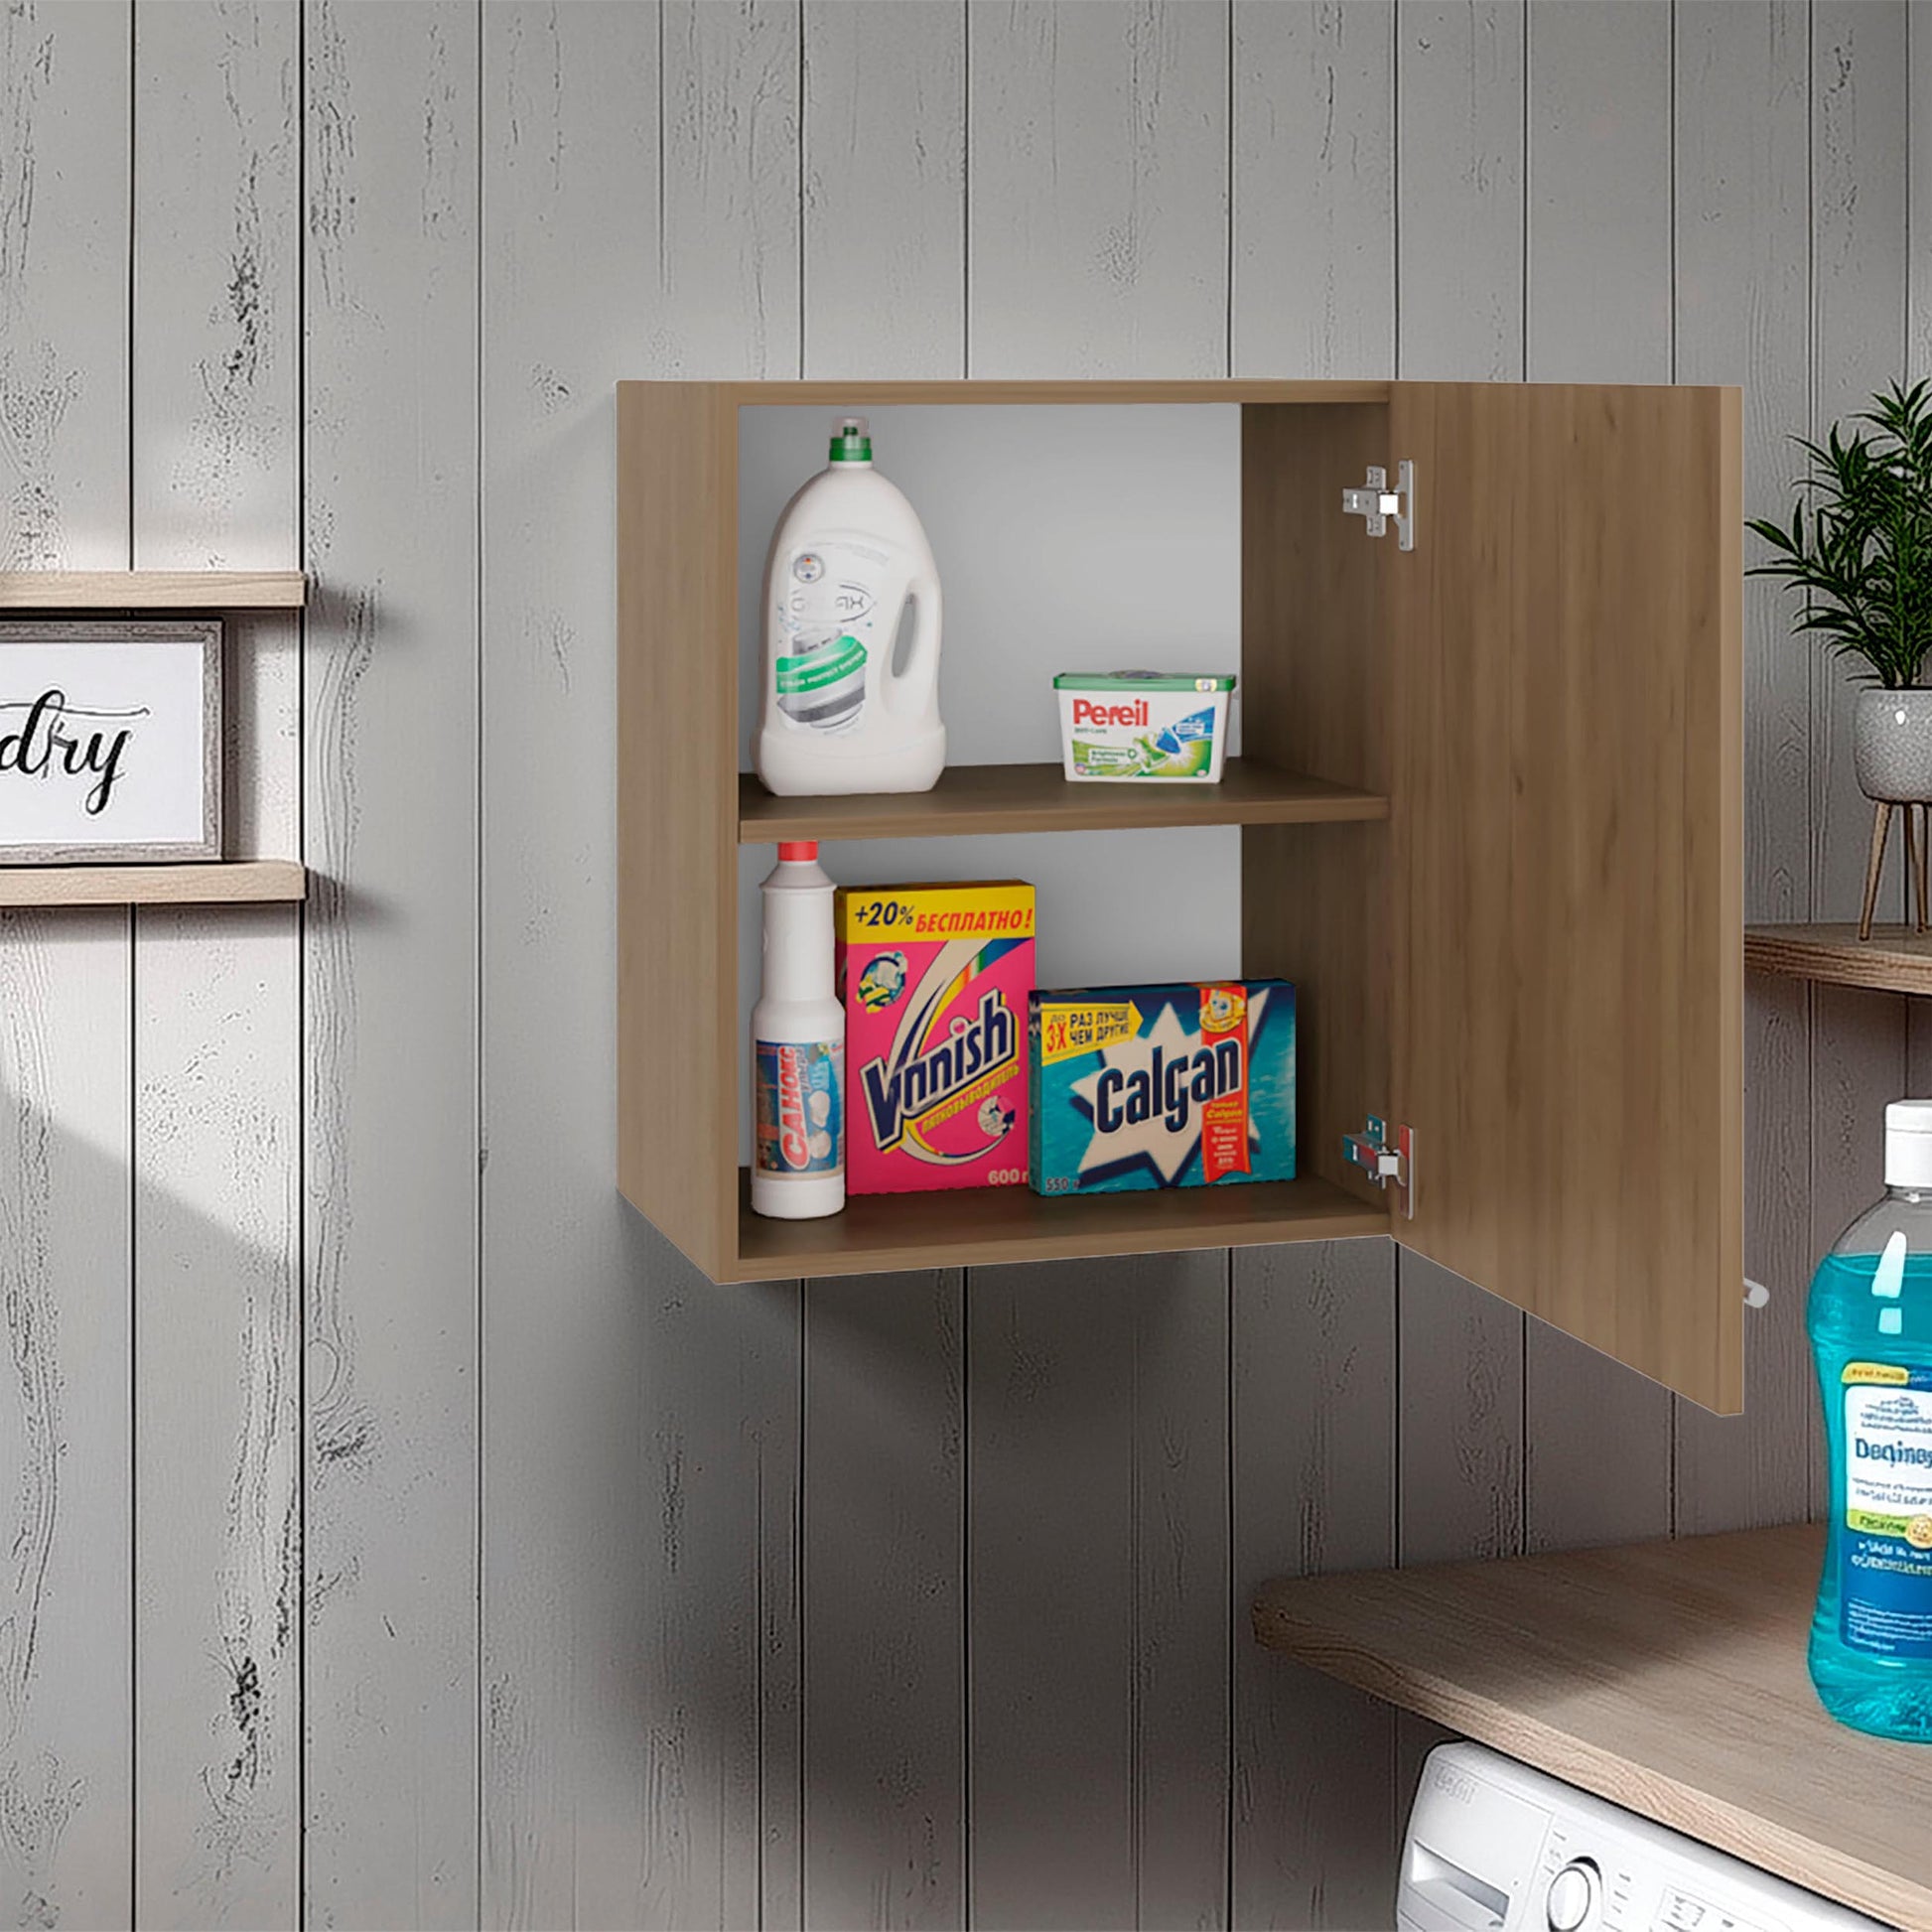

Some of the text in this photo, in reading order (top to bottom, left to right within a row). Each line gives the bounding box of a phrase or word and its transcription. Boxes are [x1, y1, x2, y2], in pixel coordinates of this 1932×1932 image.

[855, 901, 914, 926] +20%
[914, 908, 1034, 933] БЕСПЛАТНО!
[1069, 1012, 1093, 1029] РАЗ
[1069, 1029, 1093, 1045] ЧЕМ
[1097, 1040, 1239, 1133] Calgan
[988, 1169, 1020, 1184] 600
[1045, 1176, 1069, 1192] 550
